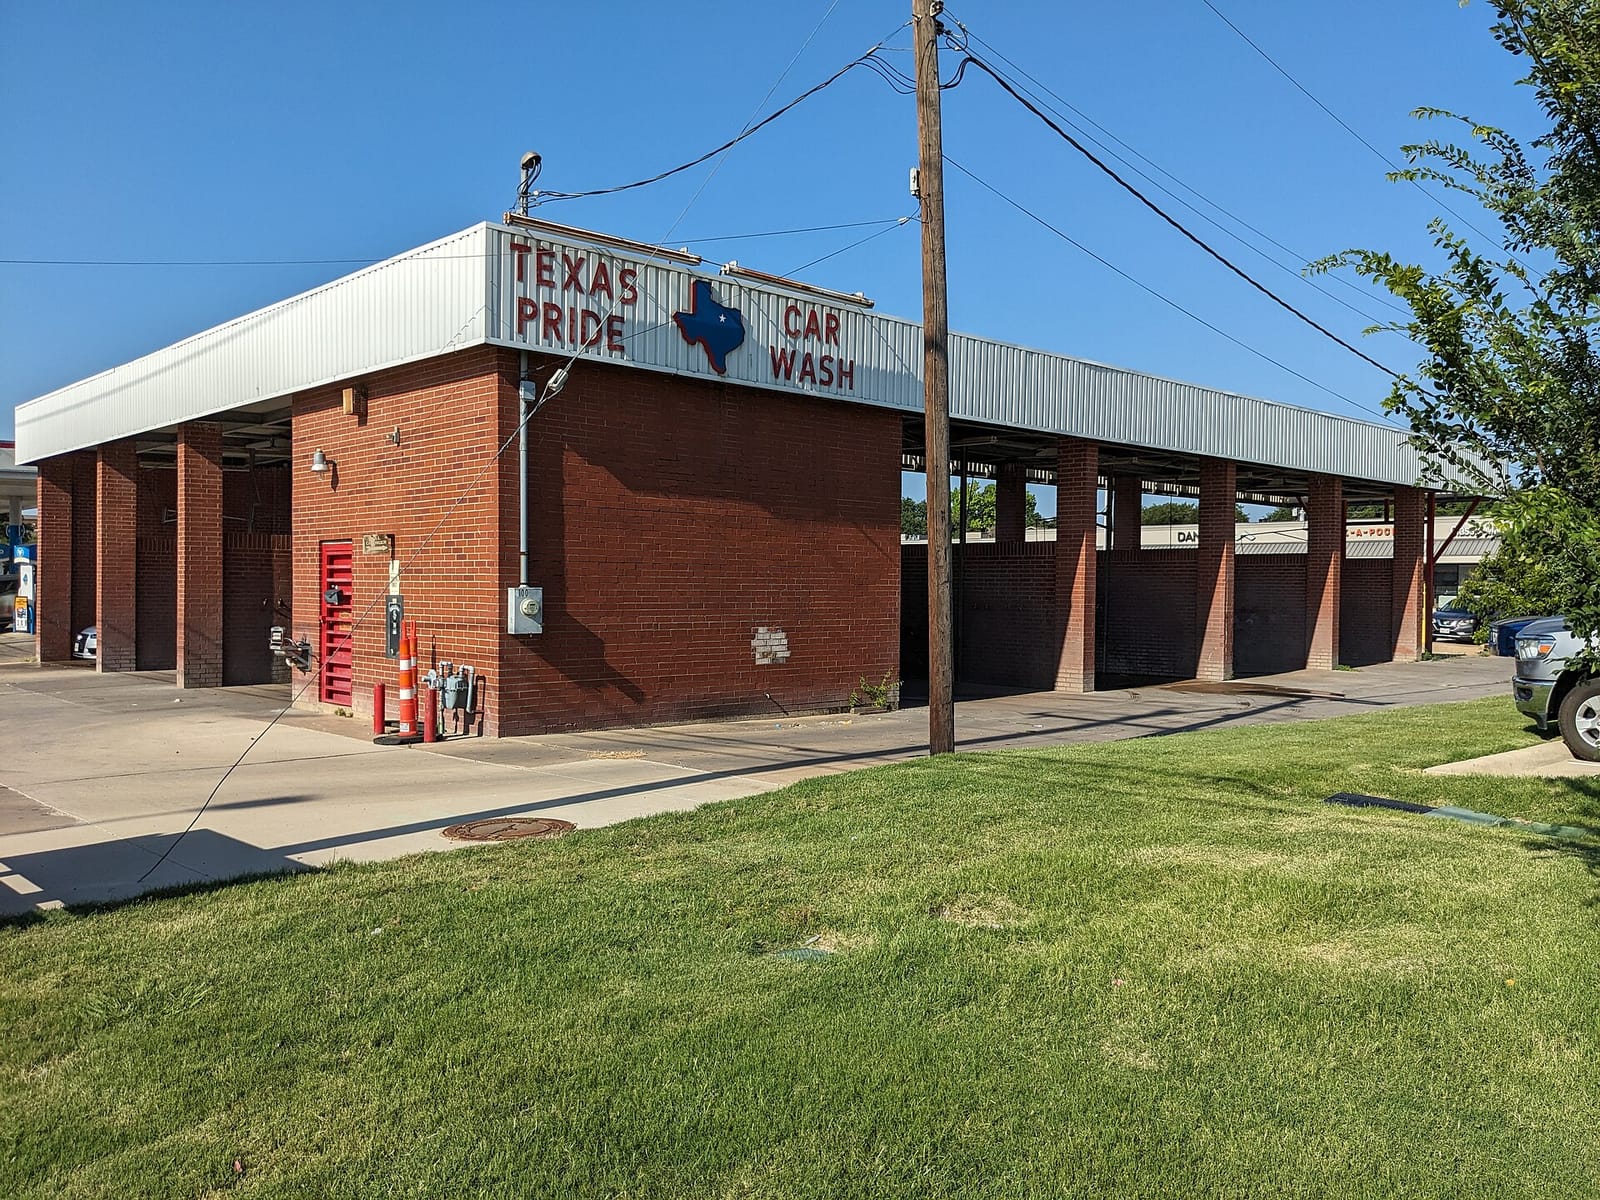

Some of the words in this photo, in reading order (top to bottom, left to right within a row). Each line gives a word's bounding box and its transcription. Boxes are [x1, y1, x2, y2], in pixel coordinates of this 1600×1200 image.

[510, 242, 638, 305] TEXAS
[517, 296, 625, 352] PRIDE
[784, 304, 839, 347] CAR
[770, 345, 854, 390] WASH
